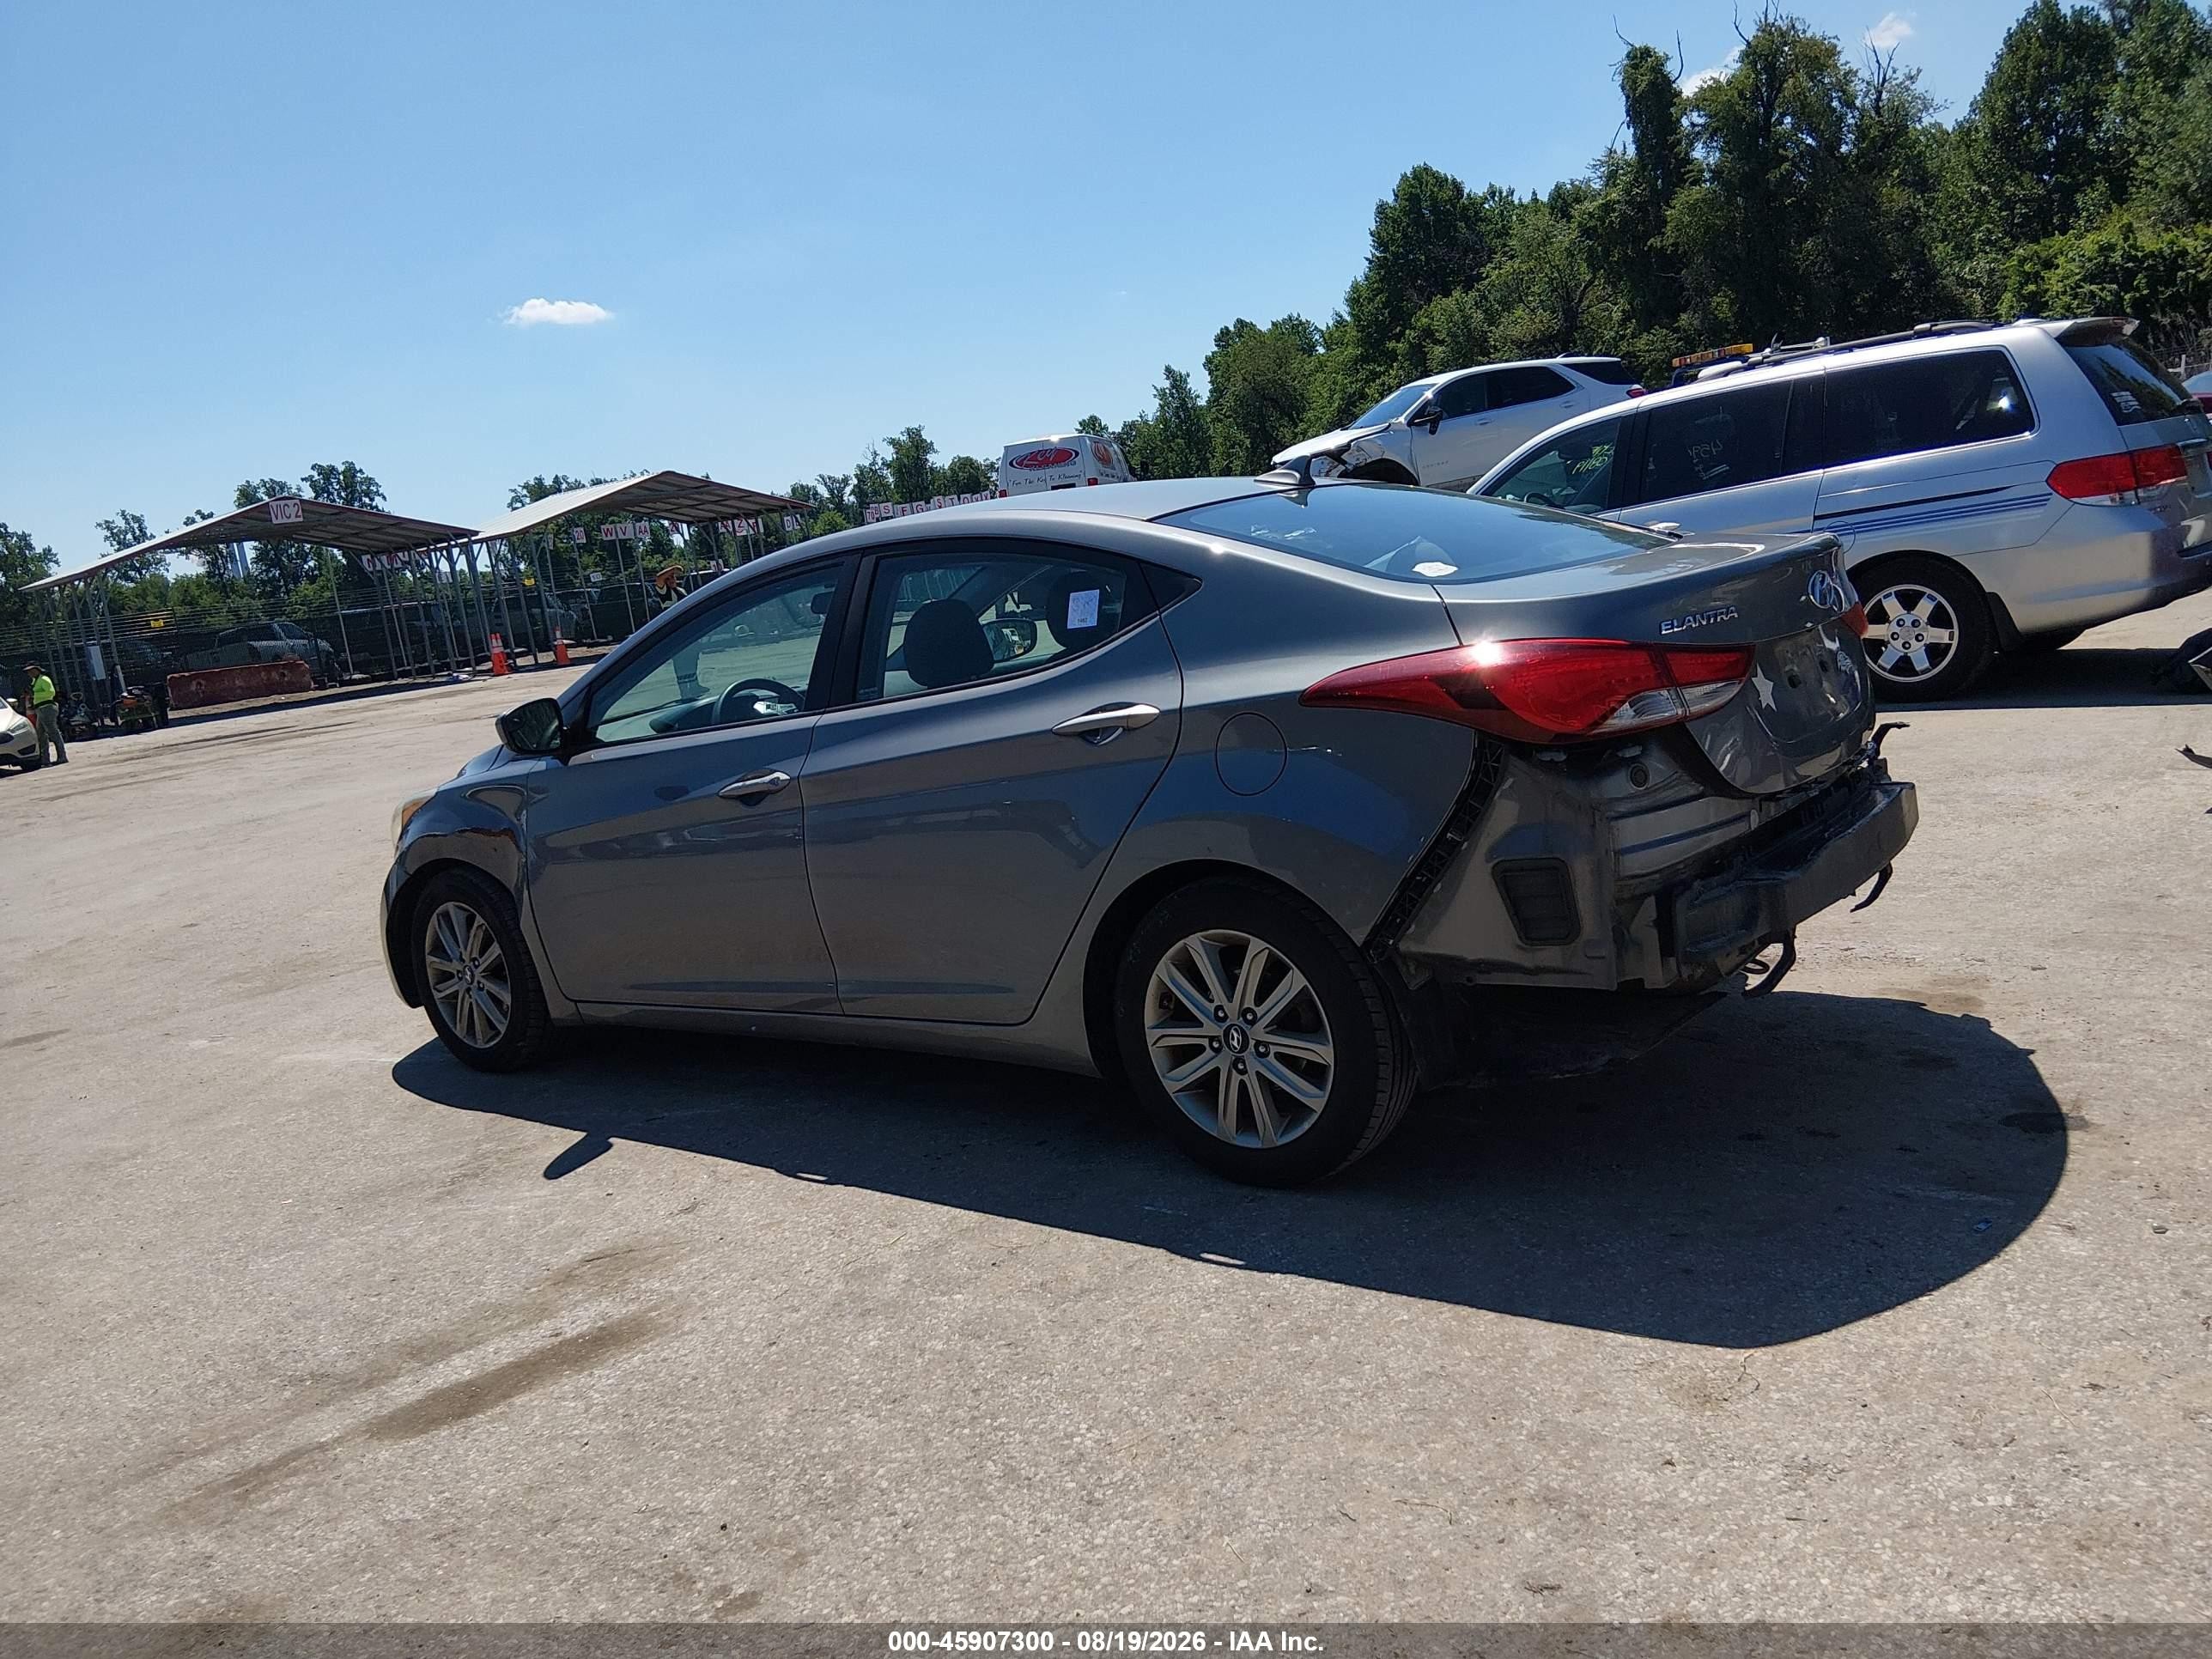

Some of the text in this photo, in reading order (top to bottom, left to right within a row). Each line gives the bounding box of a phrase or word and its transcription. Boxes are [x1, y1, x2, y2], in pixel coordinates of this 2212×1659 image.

[270, 502, 301, 520] VIC 2
[603, 526, 614, 538] W
[619, 526, 627, 537] V
[638, 525, 648, 536] AA
[1661, 606, 1738, 635] ELANTRA
